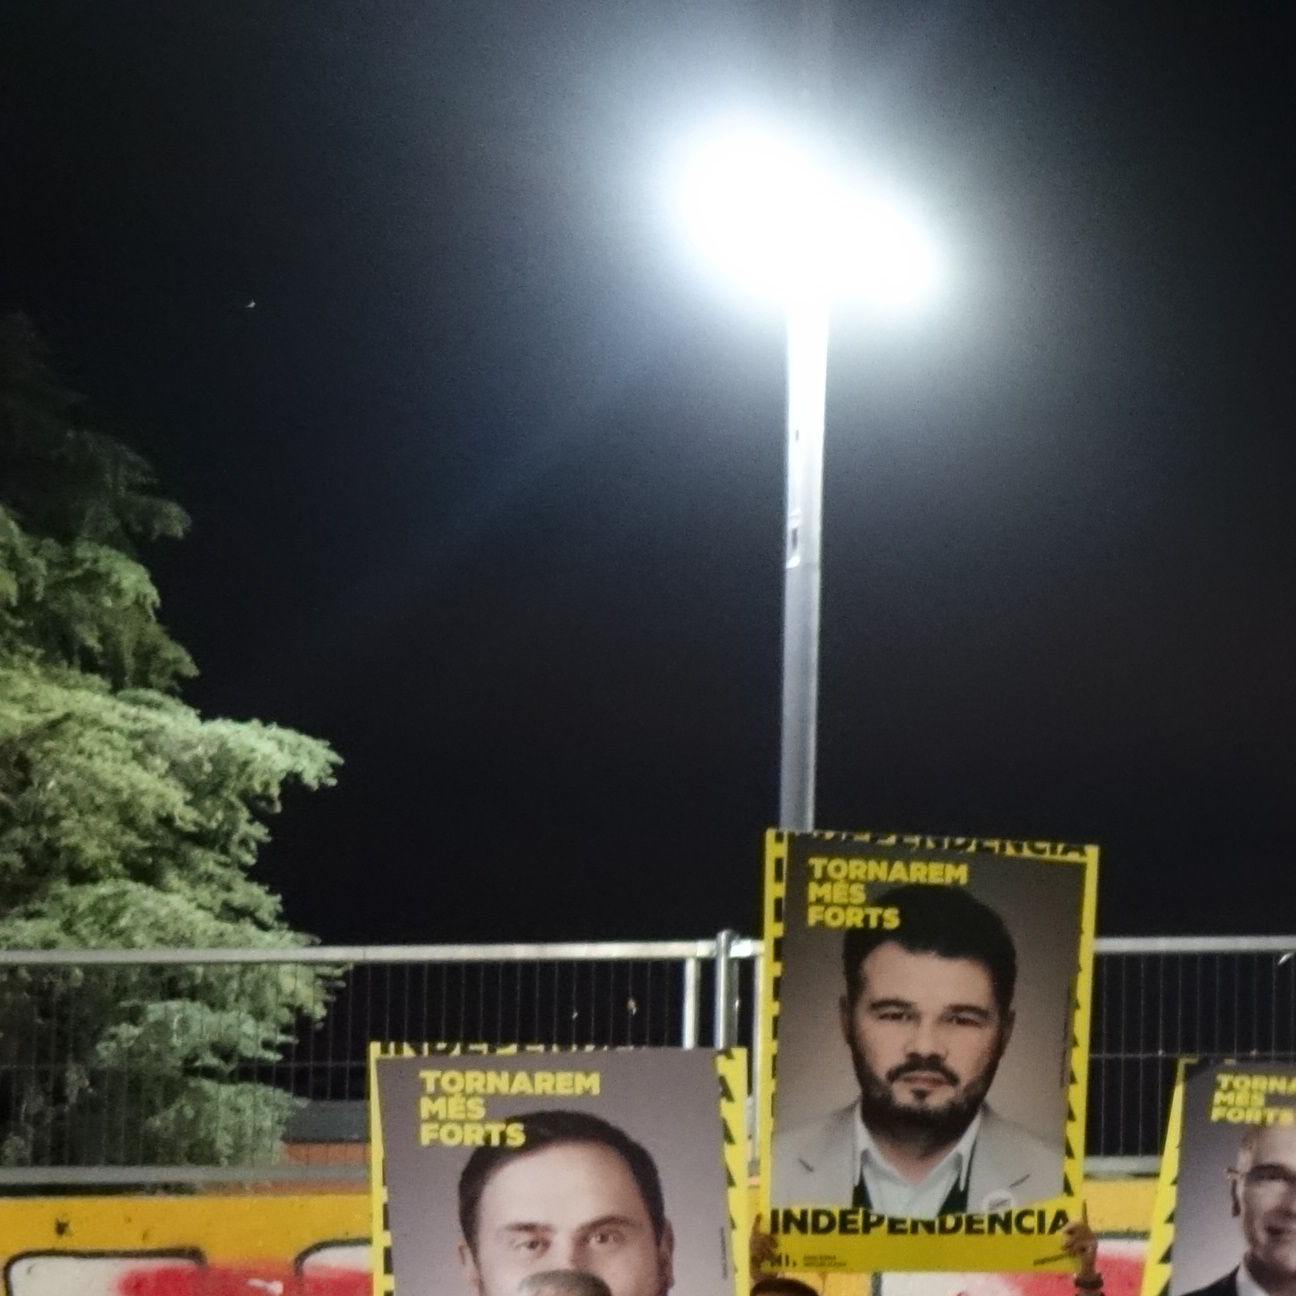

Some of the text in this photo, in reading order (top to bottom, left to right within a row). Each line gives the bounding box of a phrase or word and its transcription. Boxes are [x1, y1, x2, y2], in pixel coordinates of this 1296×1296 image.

[808, 857, 969, 885] TORNAREM
[808, 880, 865, 904] MÉS
[808, 906, 900, 929] FORTS
[419, 1071, 601, 1096] TORNAREM
[420, 1092, 485, 1121] MÉS
[420, 1122, 526, 1147] FORTS
